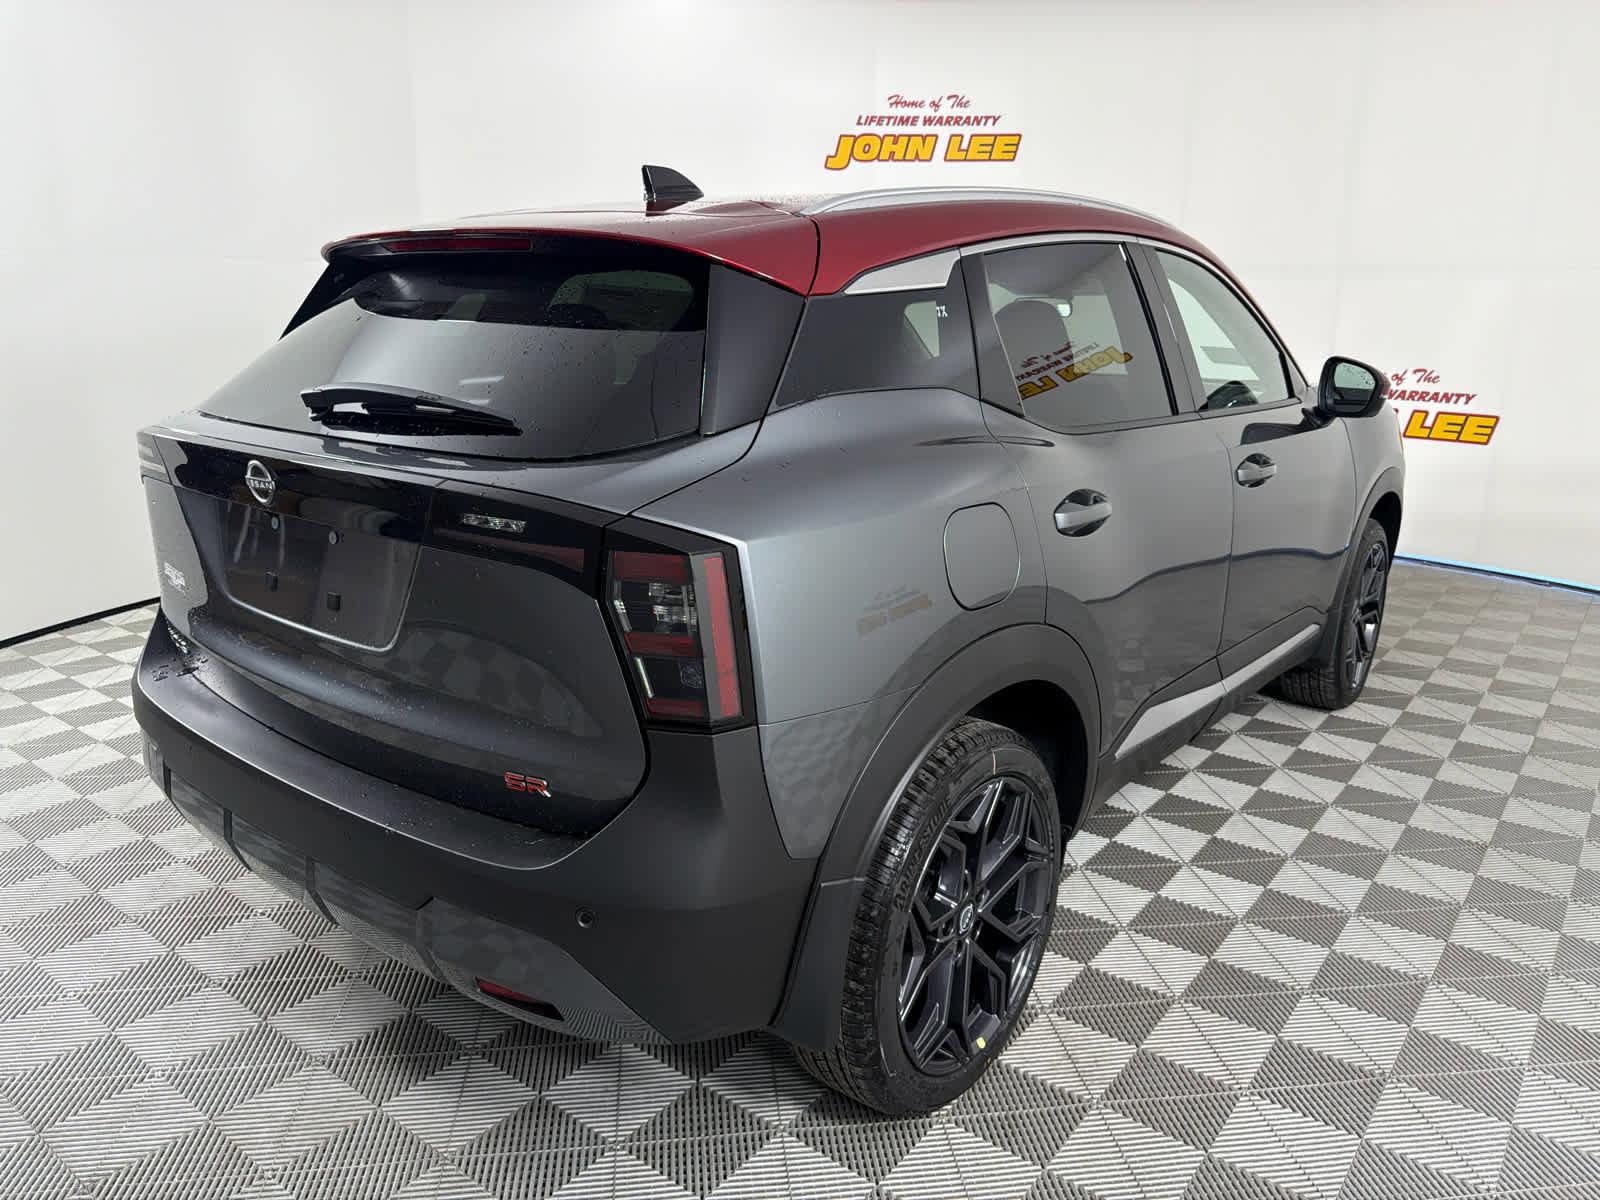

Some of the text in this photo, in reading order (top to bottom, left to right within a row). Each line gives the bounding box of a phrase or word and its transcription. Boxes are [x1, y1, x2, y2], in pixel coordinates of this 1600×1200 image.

[888, 94, 971, 112] Home of The
[856, 115, 1001, 127] LIFETIME WARRANTY
[824, 133, 1022, 170] JOHN LEE
[1391, 368, 1441, 386] of The
[1403, 409, 1500, 446] LEE
[504, 771, 552, 798] SR
